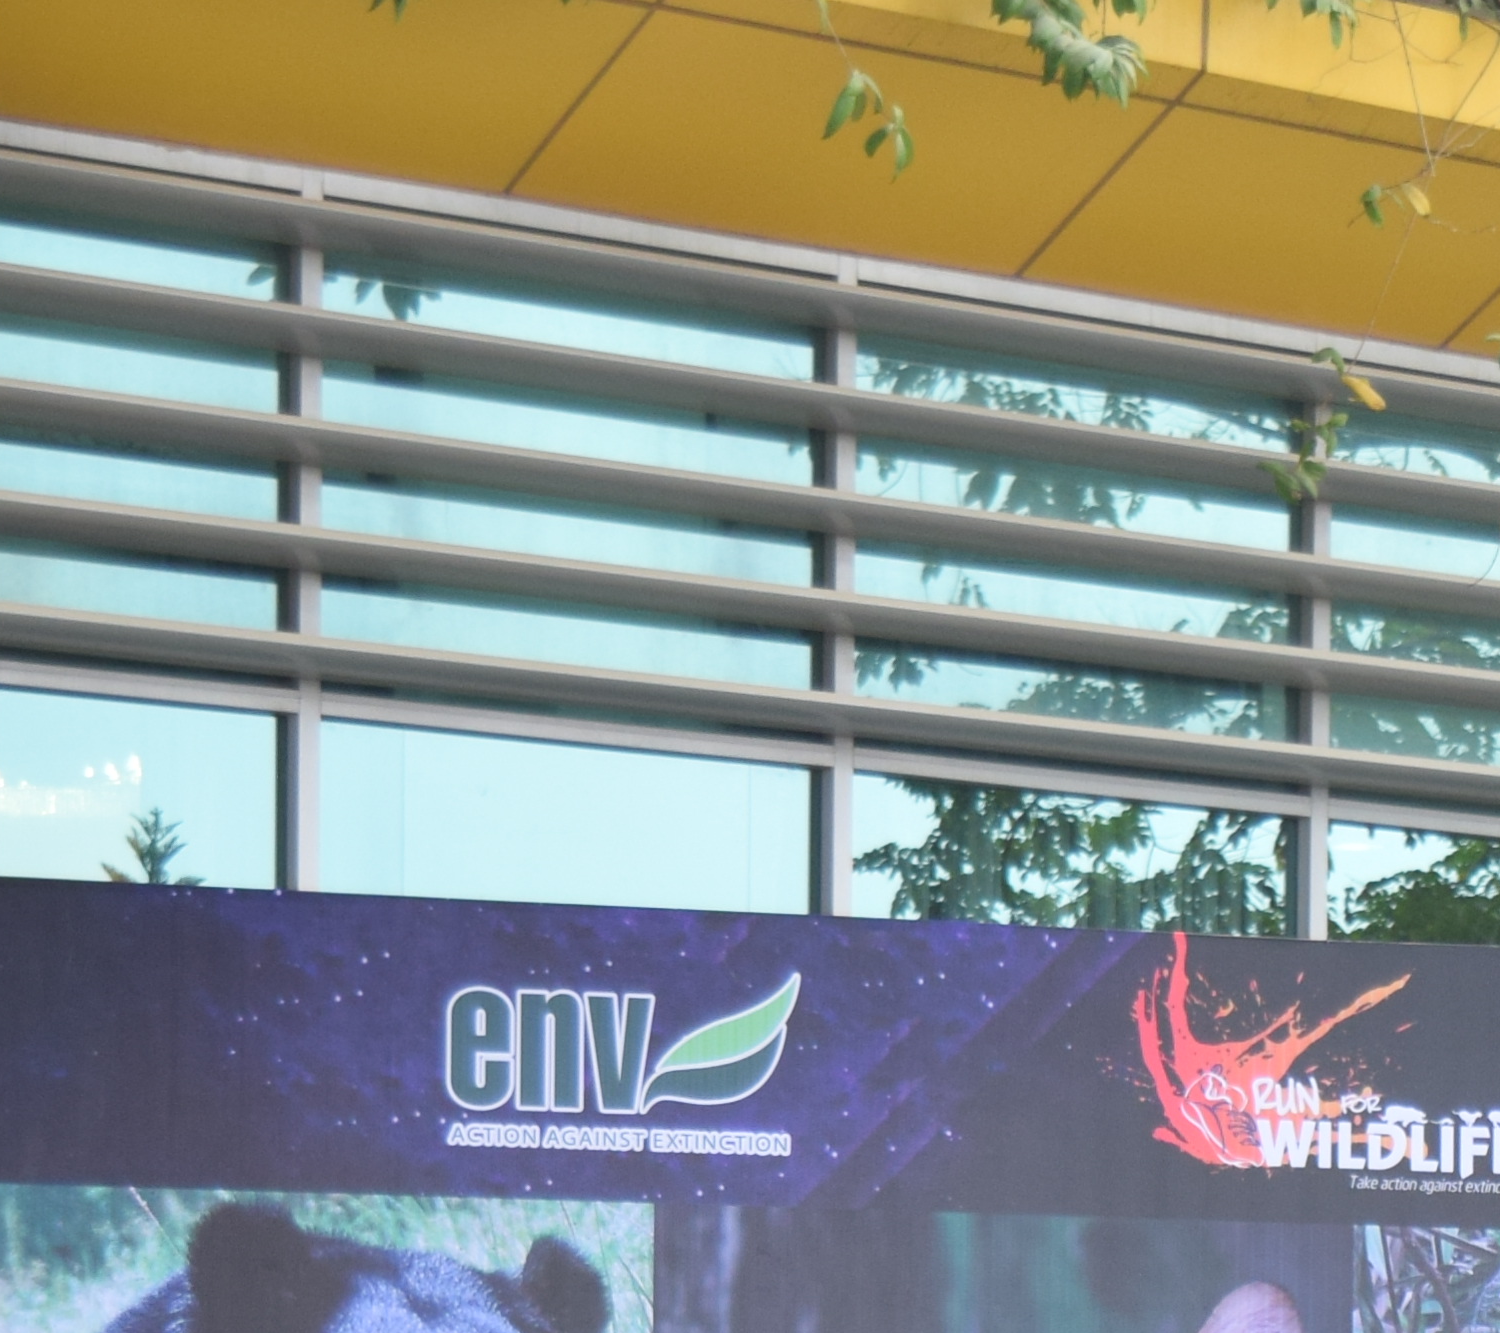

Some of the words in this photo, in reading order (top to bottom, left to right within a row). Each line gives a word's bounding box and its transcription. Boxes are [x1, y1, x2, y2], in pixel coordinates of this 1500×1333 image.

[446, 986, 655, 1114] env
[1252, 1077, 1320, 1117] RUN
[1341, 1095, 1382, 1115] FOR
[448, 1122, 540, 1148] ACTION
[542, 1125, 647, 1151] AGAINST
[649, 1129, 791, 1156] EXTINCTION
[1350, 1175, 1378, 1190] Take
[1381, 1177, 1417, 1191] action
[1420, 1179, 1462, 1195] against
